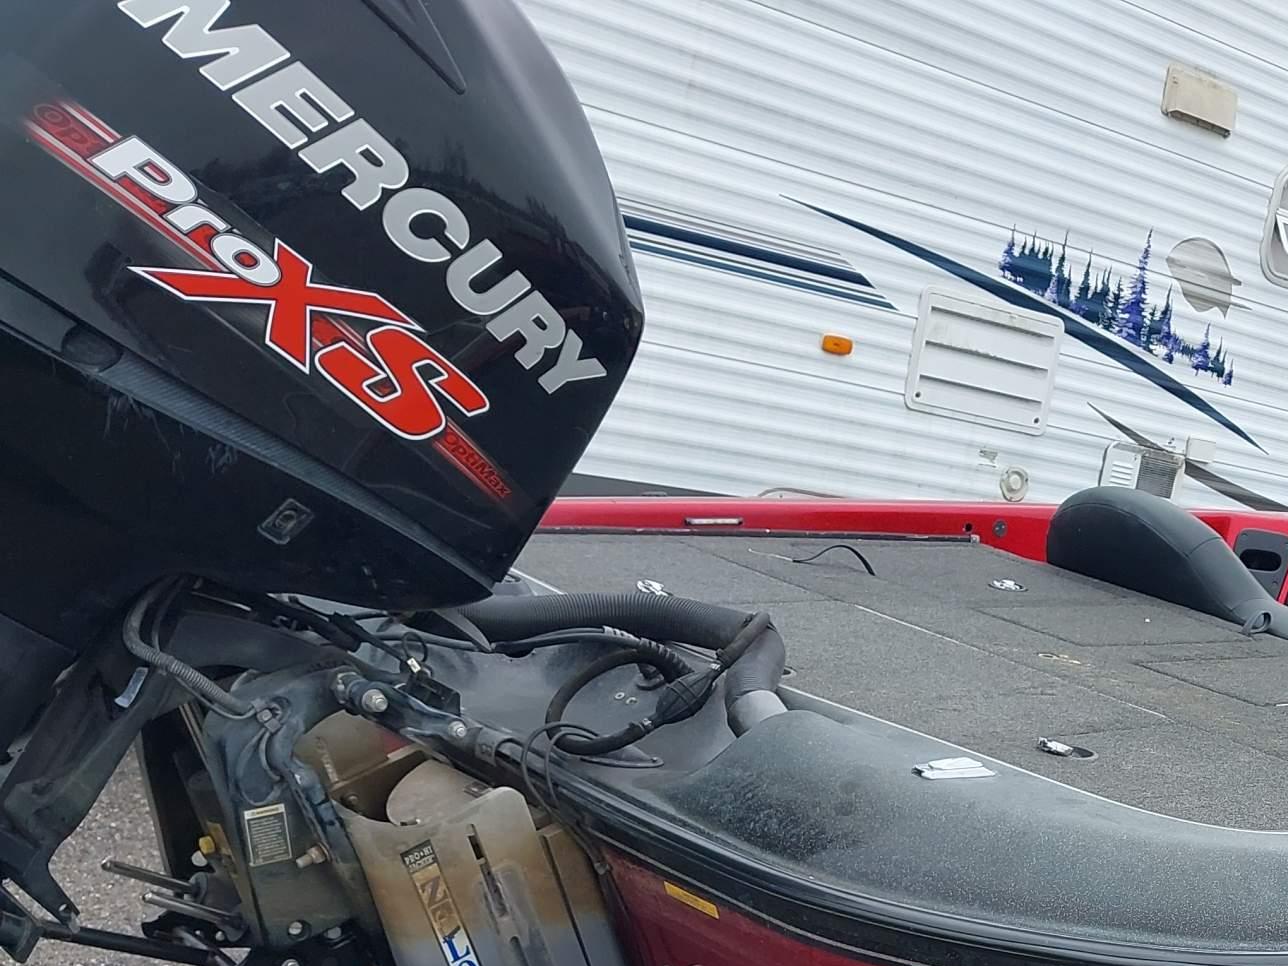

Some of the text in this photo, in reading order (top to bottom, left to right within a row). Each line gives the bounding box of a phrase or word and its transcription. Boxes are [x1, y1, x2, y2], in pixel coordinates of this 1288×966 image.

[89, 134, 490, 441] Pro XS
[117, 0, 608, 395] MERCURY
[443, 430, 514, 499] OptiMax
